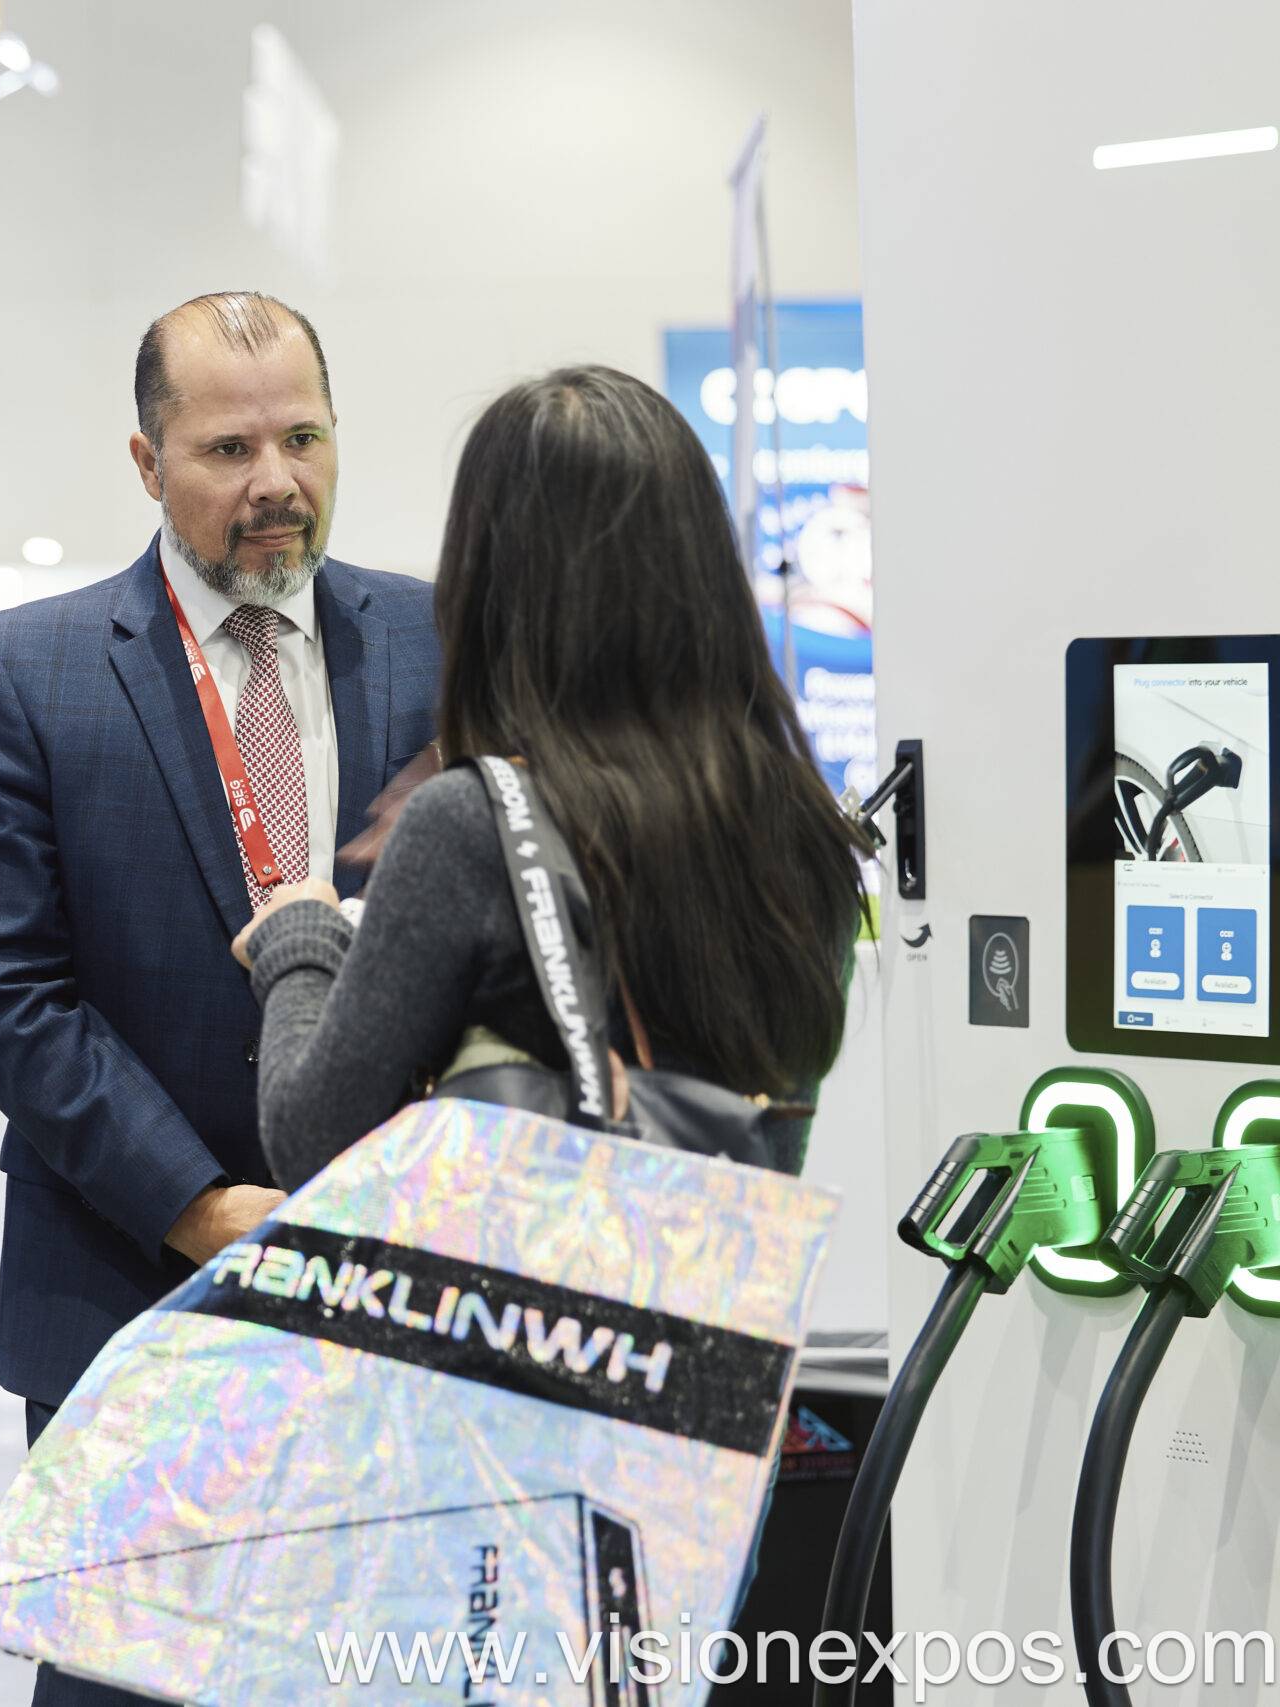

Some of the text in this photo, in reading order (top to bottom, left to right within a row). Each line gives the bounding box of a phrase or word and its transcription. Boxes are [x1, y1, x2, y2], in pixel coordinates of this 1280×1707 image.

[1188, 678, 1202, 686] into
[1204, 679, 1221, 688] your
[1222, 678, 1248, 686] vehicle
[230, 780, 246, 807] SEG
[906, 953, 928, 962] OPEN
[207, 1241, 674, 1394] RANKLINWH
